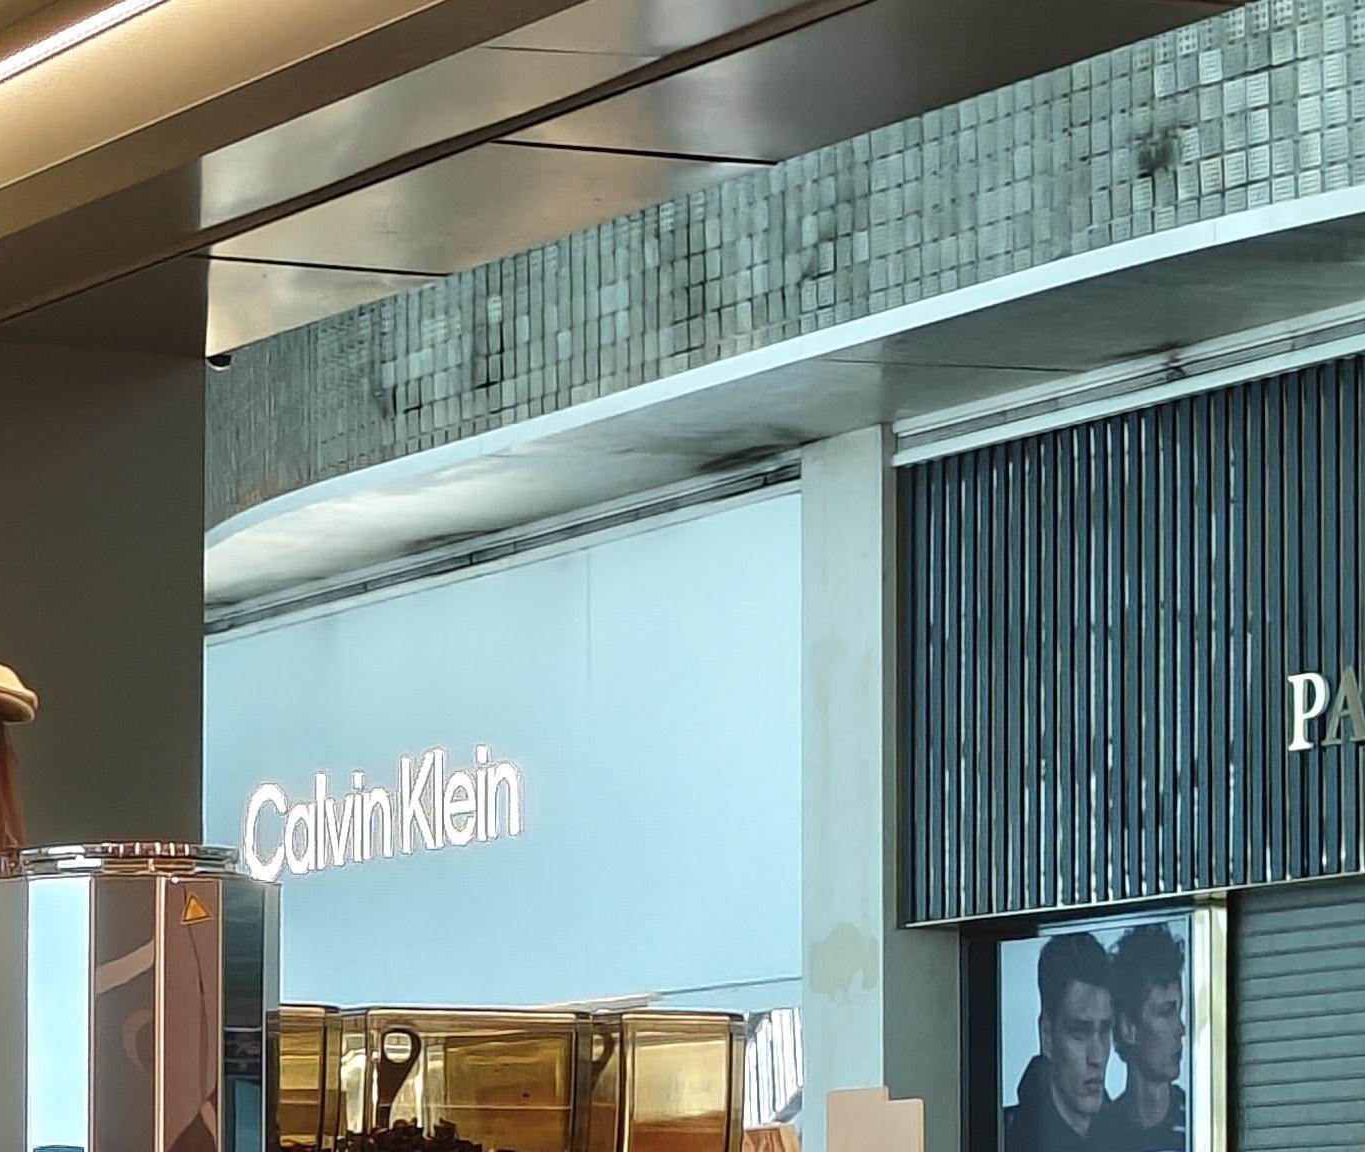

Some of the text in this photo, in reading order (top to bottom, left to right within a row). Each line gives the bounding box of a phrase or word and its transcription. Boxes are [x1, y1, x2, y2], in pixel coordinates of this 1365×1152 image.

[1287, 665, 1365, 752] PA
[243, 742, 523, 883] Calvin Klein
